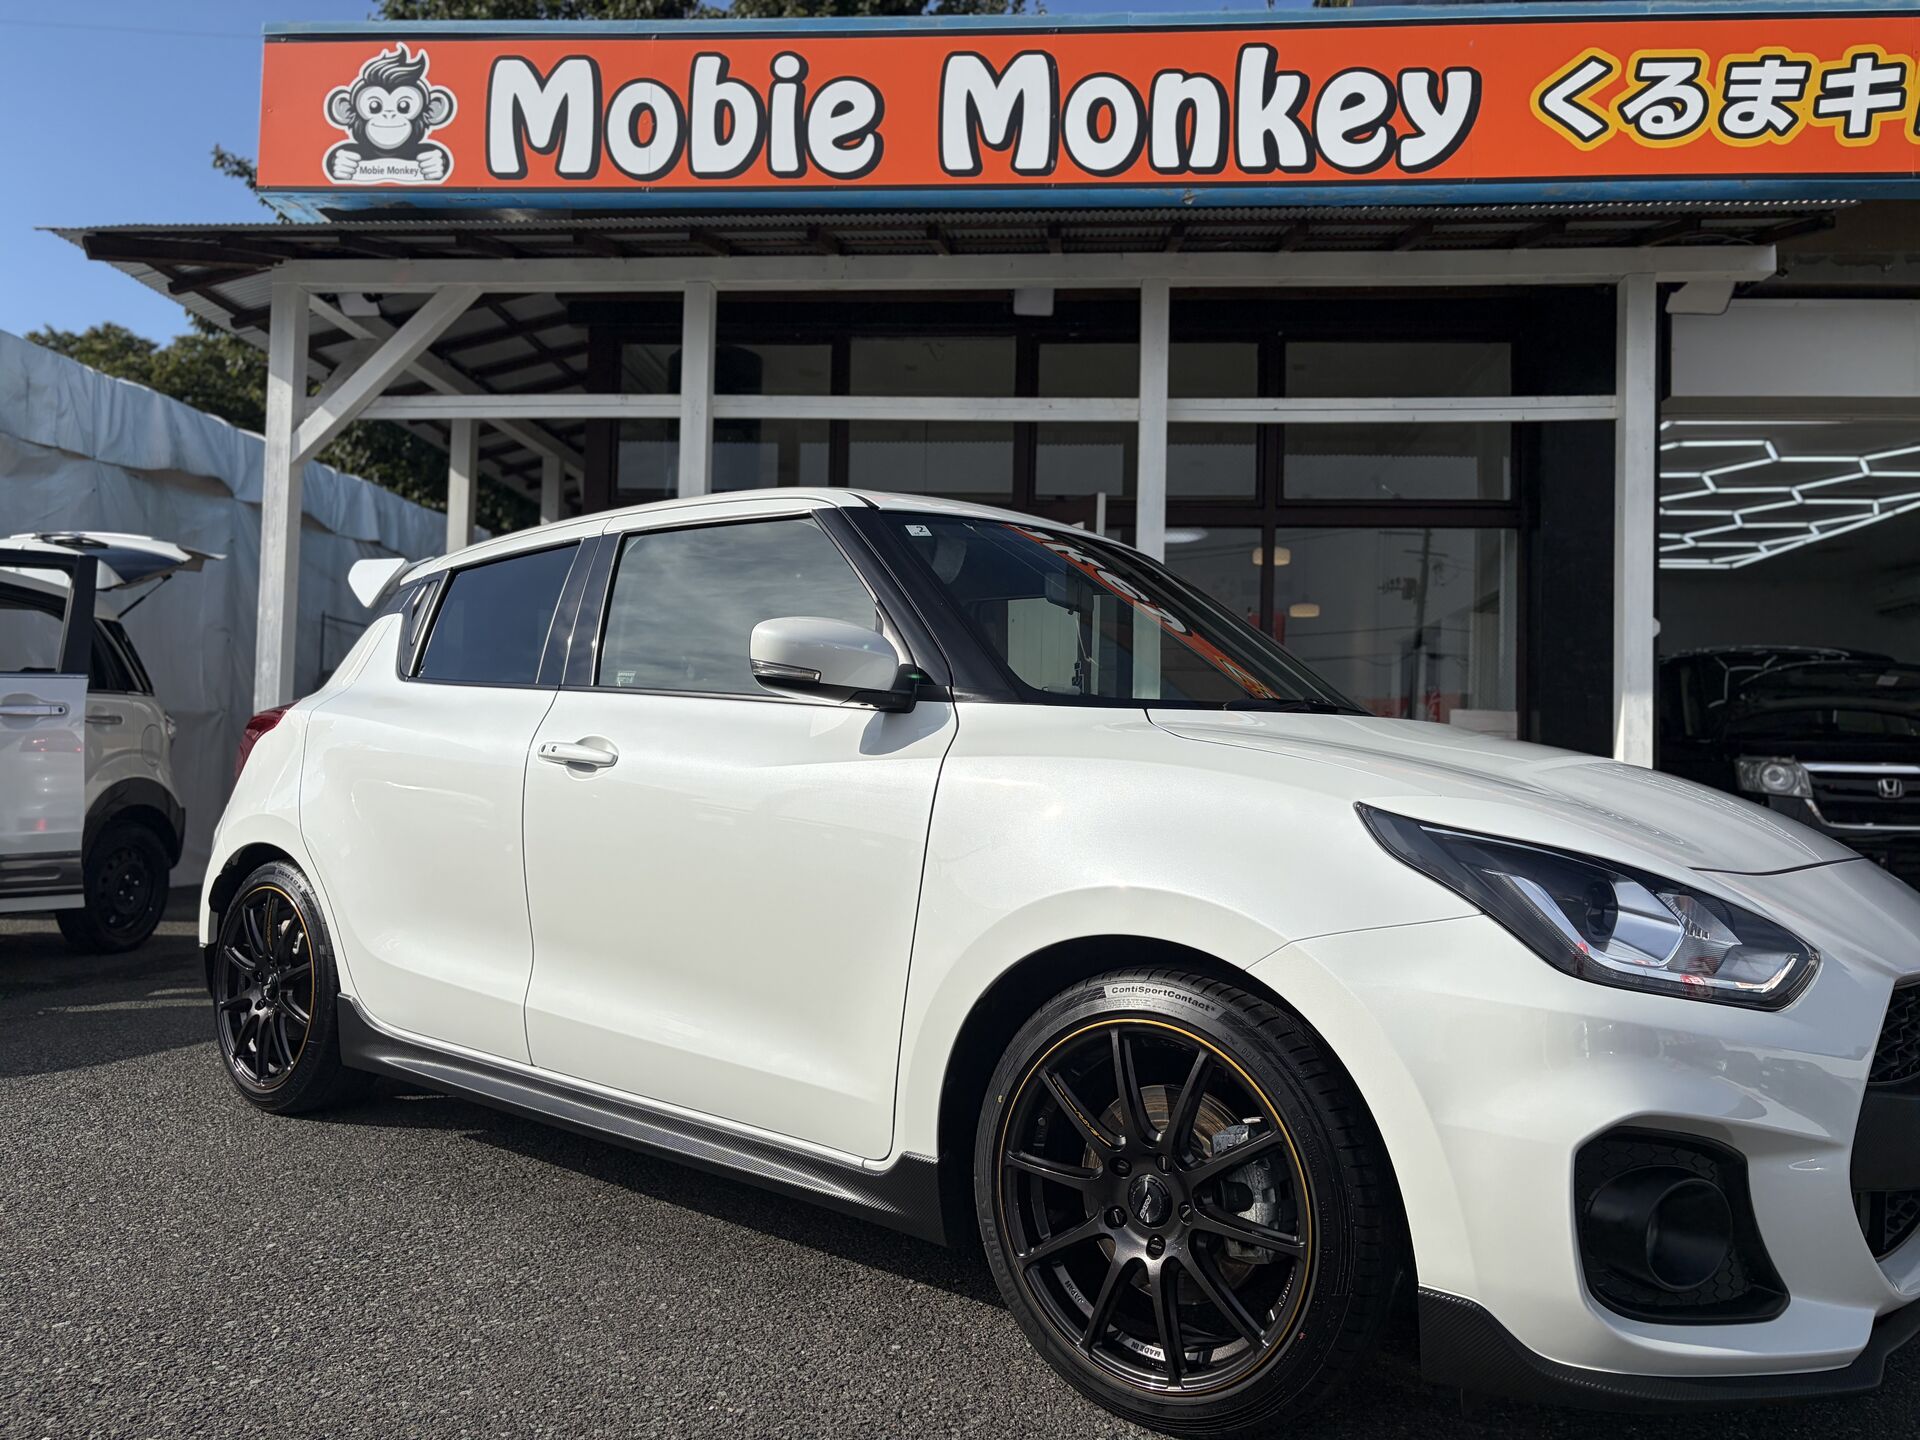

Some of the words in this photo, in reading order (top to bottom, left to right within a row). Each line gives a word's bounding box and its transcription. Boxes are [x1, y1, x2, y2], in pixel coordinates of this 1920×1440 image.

[486, 51, 884, 181] Mobie
[939, 42, 1482, 178] Monkey
[1537, 51, 1920, 144] くるまキ
[359, 165, 385, 175] Mobie
[387, 165, 419, 177] Monkey
